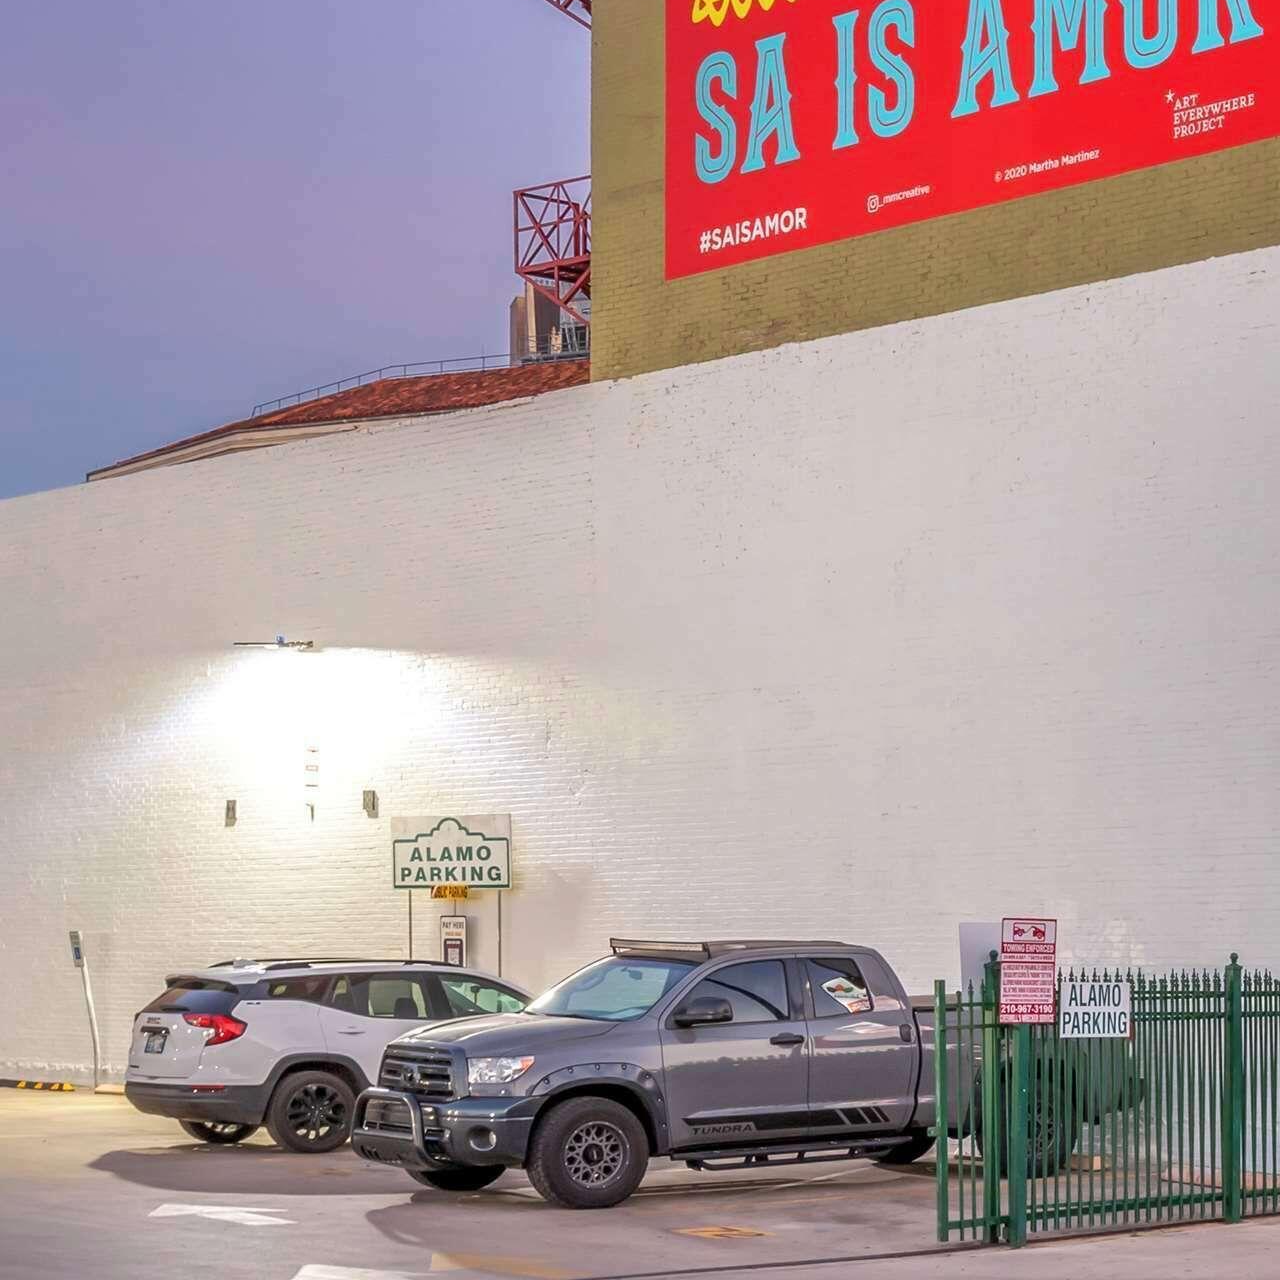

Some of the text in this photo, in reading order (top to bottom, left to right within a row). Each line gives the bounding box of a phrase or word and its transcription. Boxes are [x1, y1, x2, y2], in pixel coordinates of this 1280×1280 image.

[695, 33, 801, 184] SA
[1173, 93, 1255, 125] EVERYWHERE
[1174, 94, 1200, 110] ART
[1173, 116, 1225, 139] PROJECT
[1004, 164, 1027, 181] 2020
[1029, 157, 1059, 174] Martha
[700, 207, 808, 253] #SAISAMOR
[410, 846, 491, 862] ALAMO
[401, 866, 502, 882] PARKING
[1069, 984, 1121, 1007] ALAMO
[1062, 1011, 1127, 1034] PARKING
[692, 1124, 752, 1135] TUNDRA
